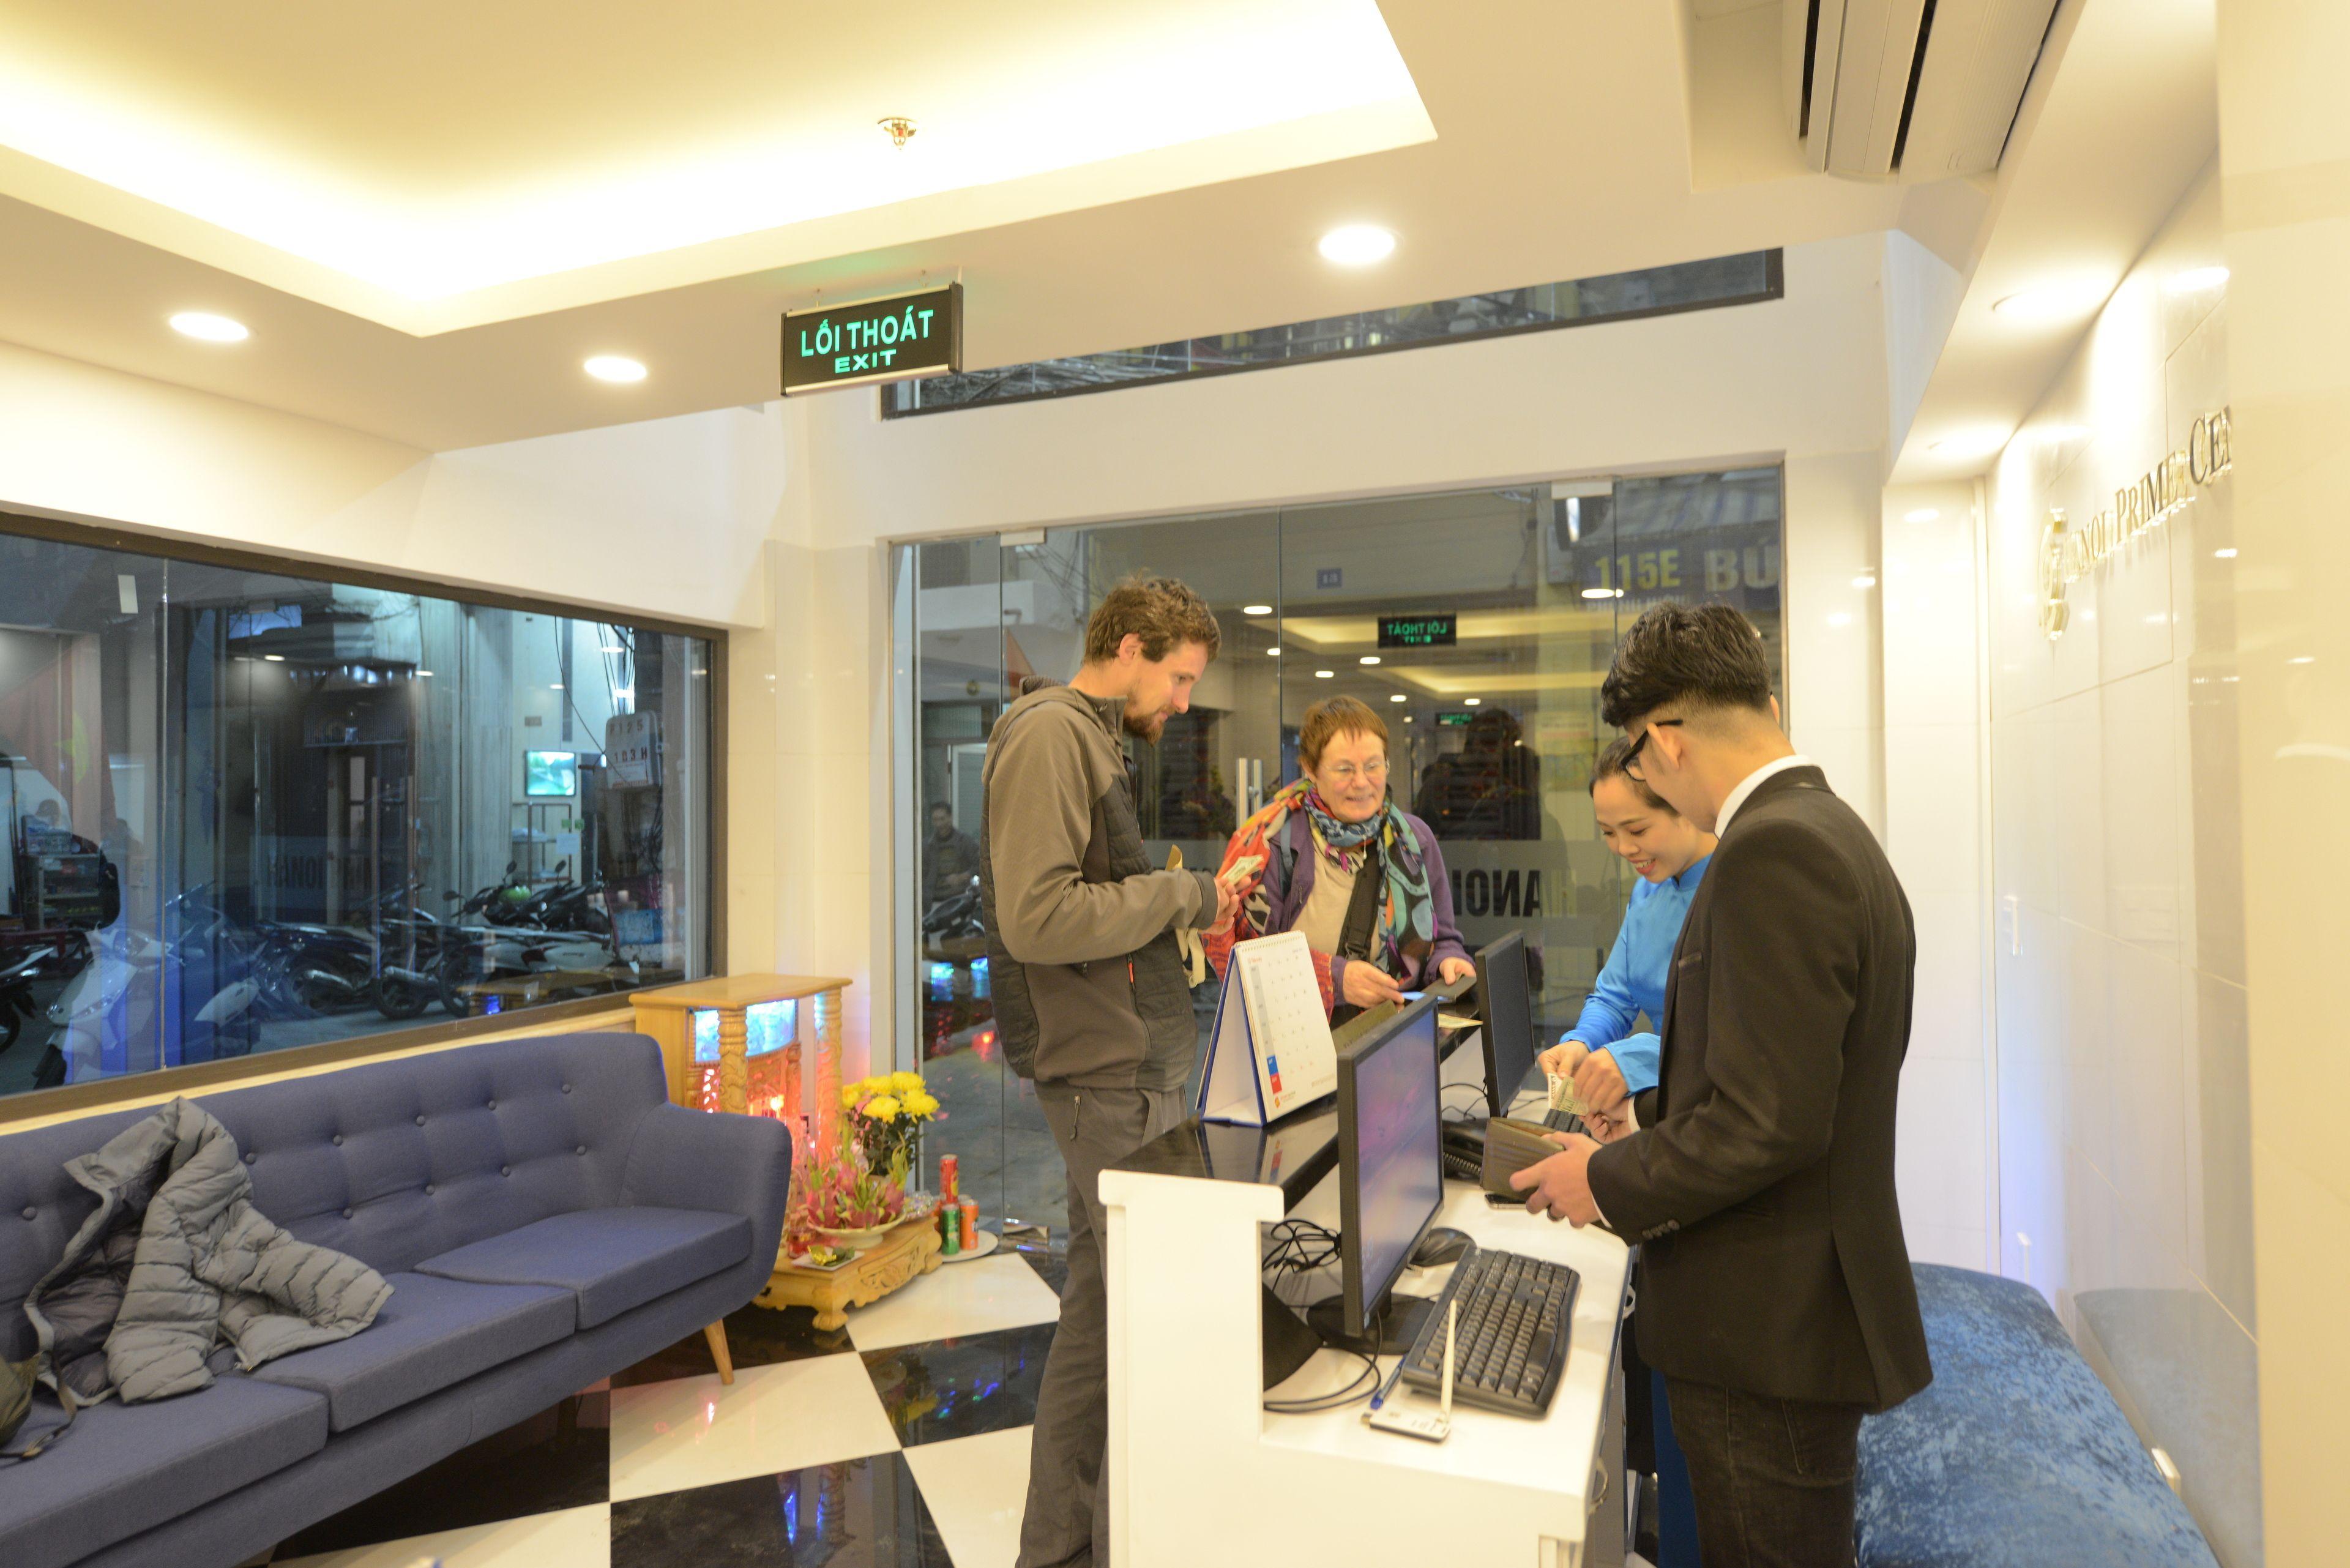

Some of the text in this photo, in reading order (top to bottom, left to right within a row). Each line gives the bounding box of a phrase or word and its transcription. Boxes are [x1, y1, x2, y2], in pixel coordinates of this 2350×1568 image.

[801, 305, 934, 357] LỐI THOÁT
[835, 349, 897, 373] EXIT
[1594, 549, 1681, 592] 115E
